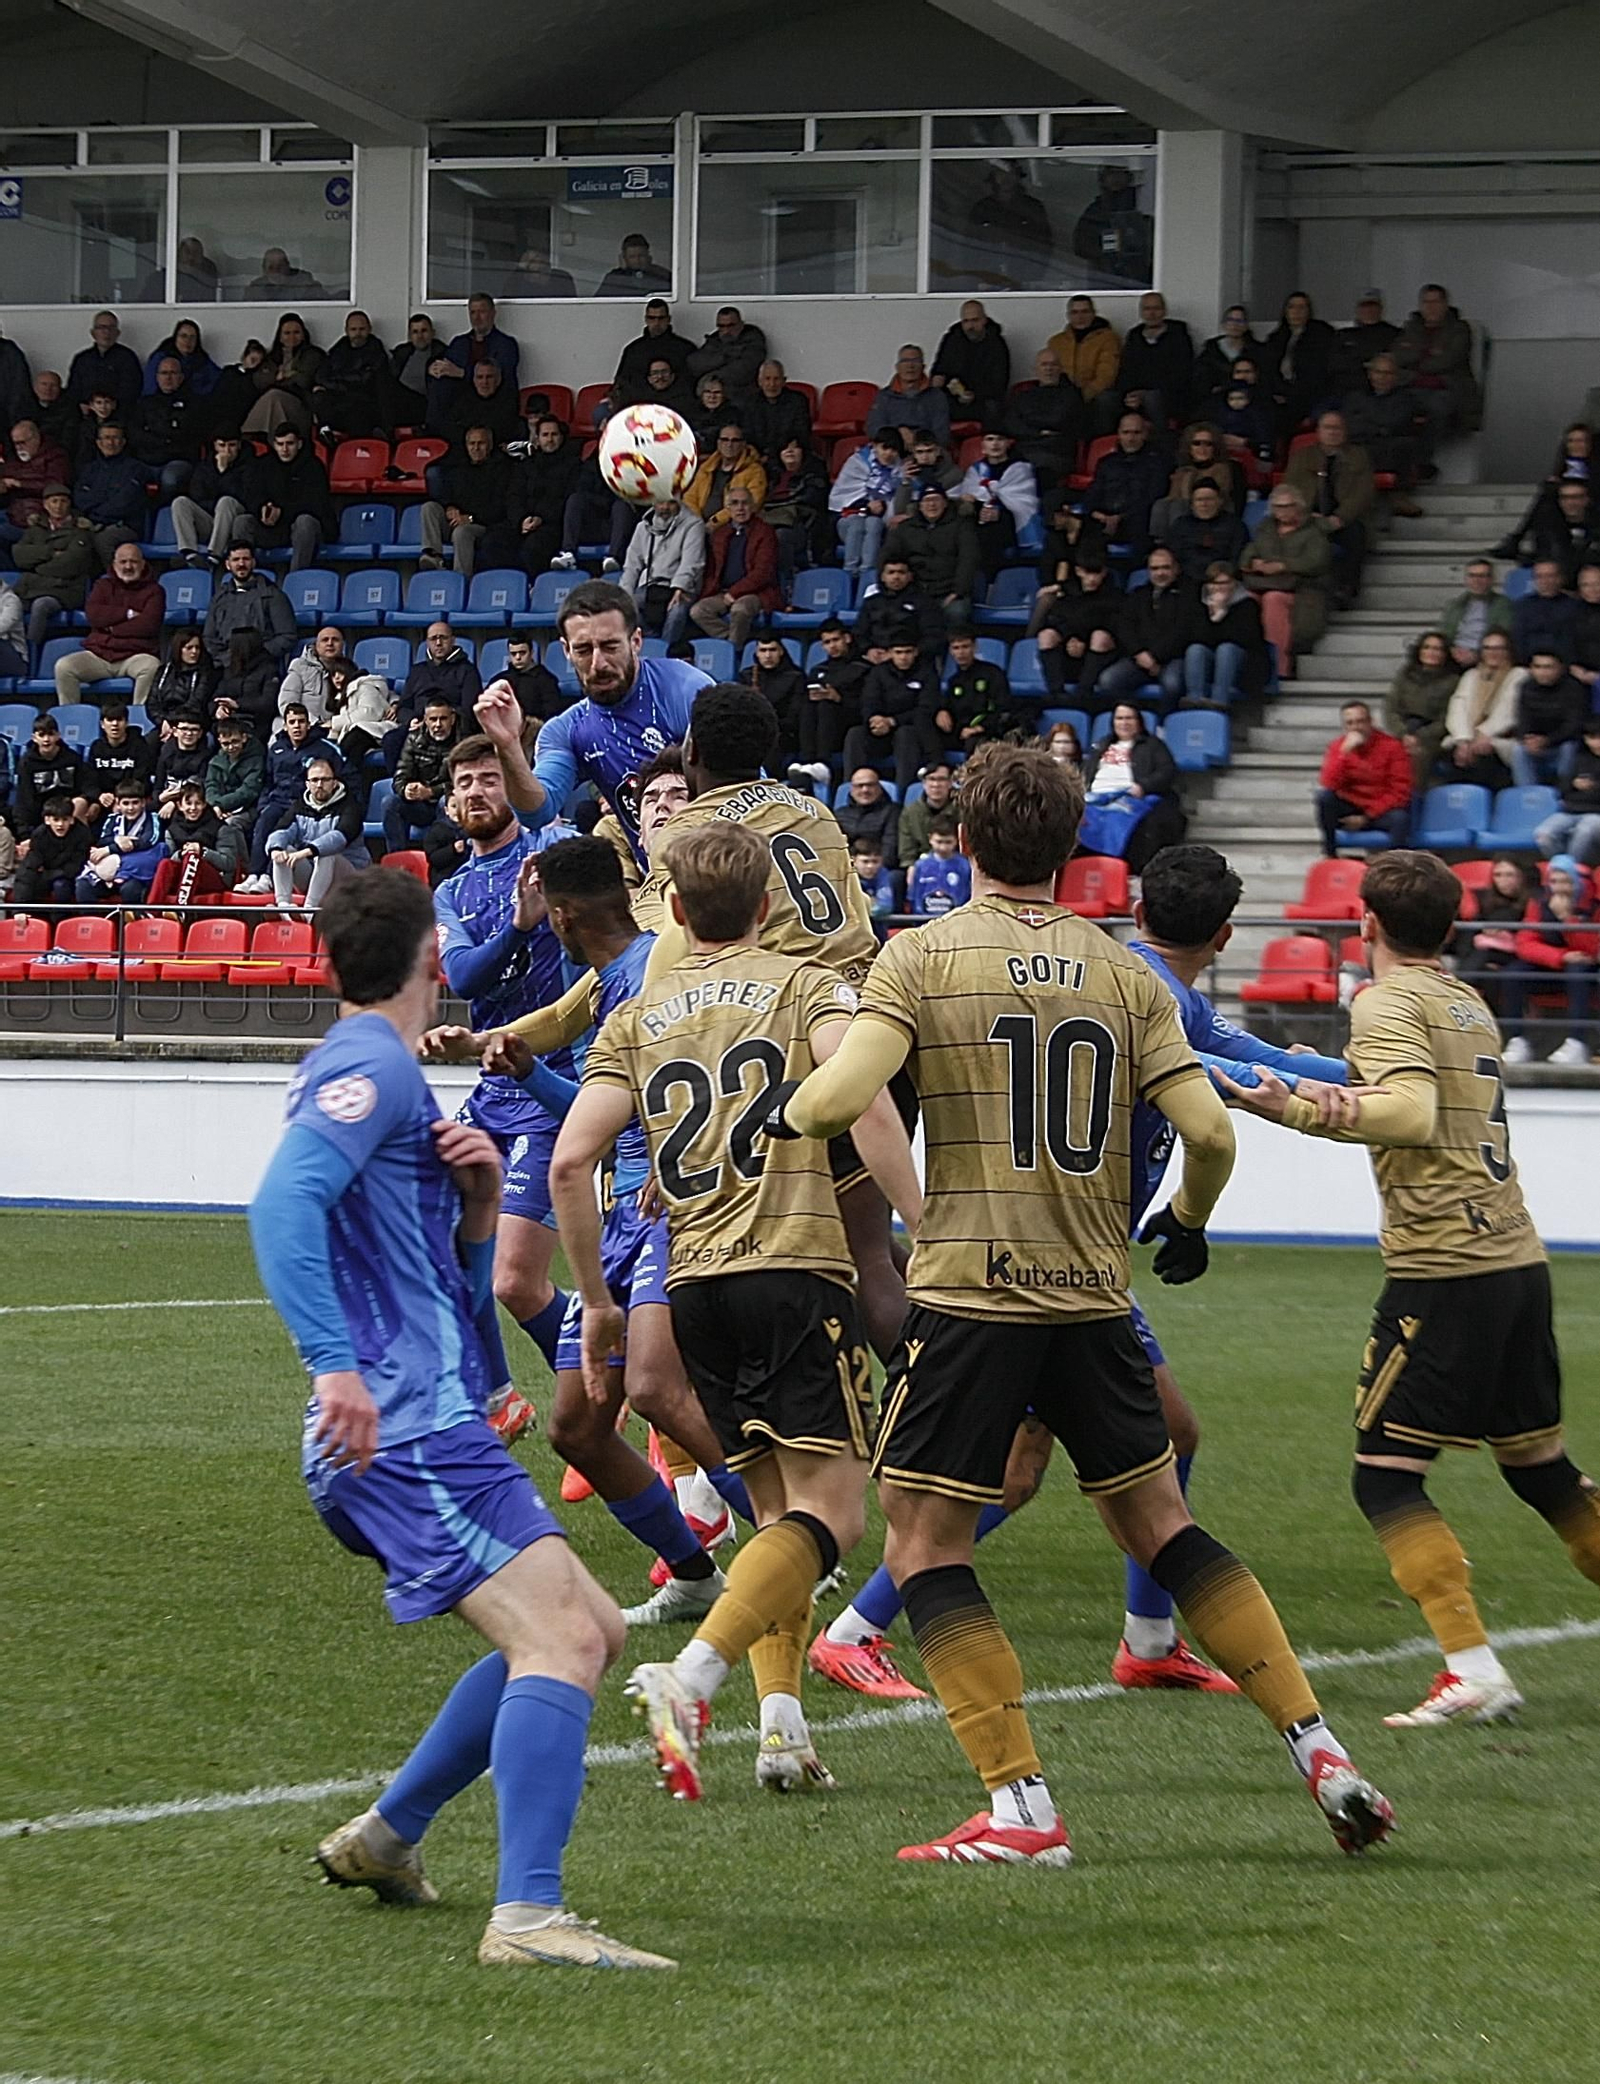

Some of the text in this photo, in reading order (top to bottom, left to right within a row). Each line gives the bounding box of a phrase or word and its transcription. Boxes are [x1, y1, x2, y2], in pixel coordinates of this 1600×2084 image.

[572, 180, 607, 192] Galicia
[609, 181, 622, 190] en
[711, 784, 818, 823] EBARBIER
[177, 854, 200, 905] SEATTLE
[769, 832, 847, 936] 6
[1006, 953, 1086, 992] GOTI
[641, 979, 780, 1040] RUPEREZ
[642, 1037, 787, 1204] 22
[987, 1014, 1116, 1175] 10
[1474, 1054, 1510, 1183] 3
